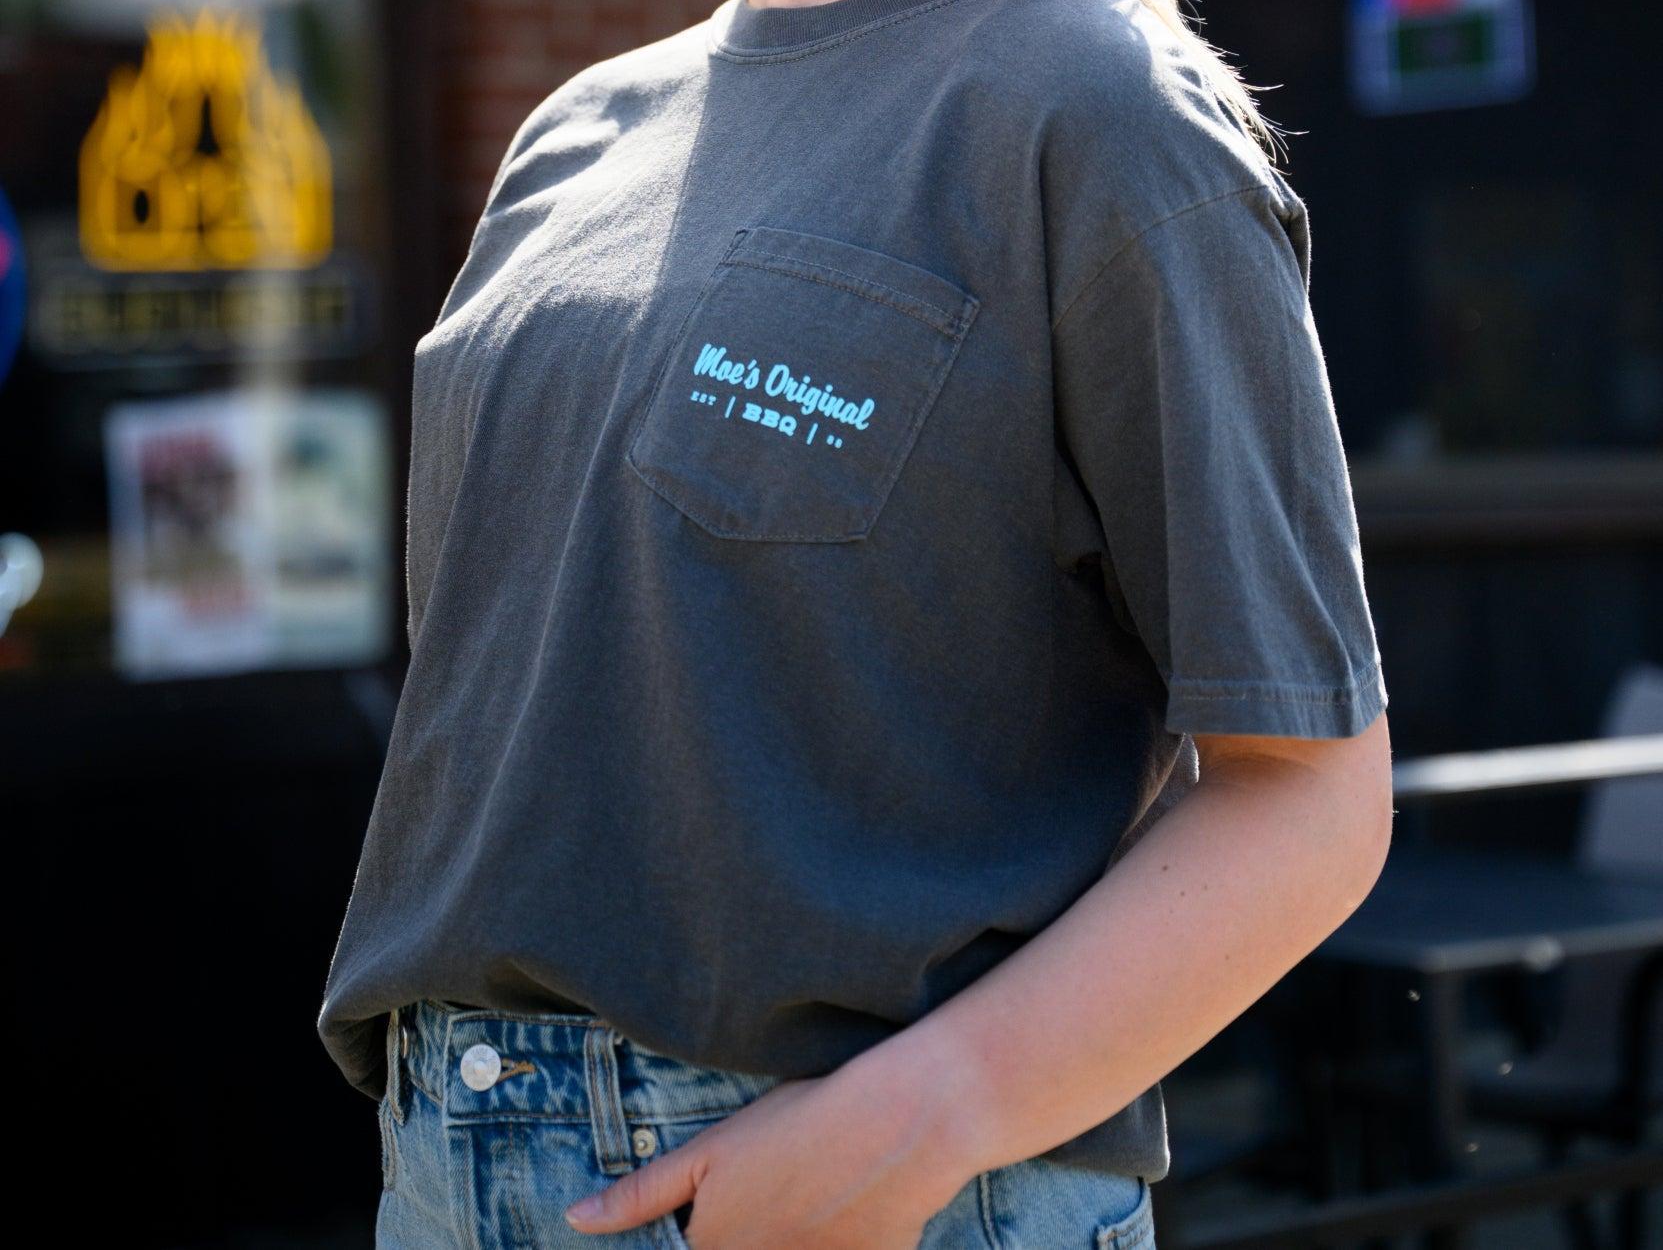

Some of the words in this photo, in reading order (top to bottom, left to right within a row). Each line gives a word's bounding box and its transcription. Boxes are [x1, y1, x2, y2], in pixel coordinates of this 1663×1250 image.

[693, 342, 761, 390] Moe's
[764, 363, 876, 431] Original
[741, 402, 798, 437] BBQ
